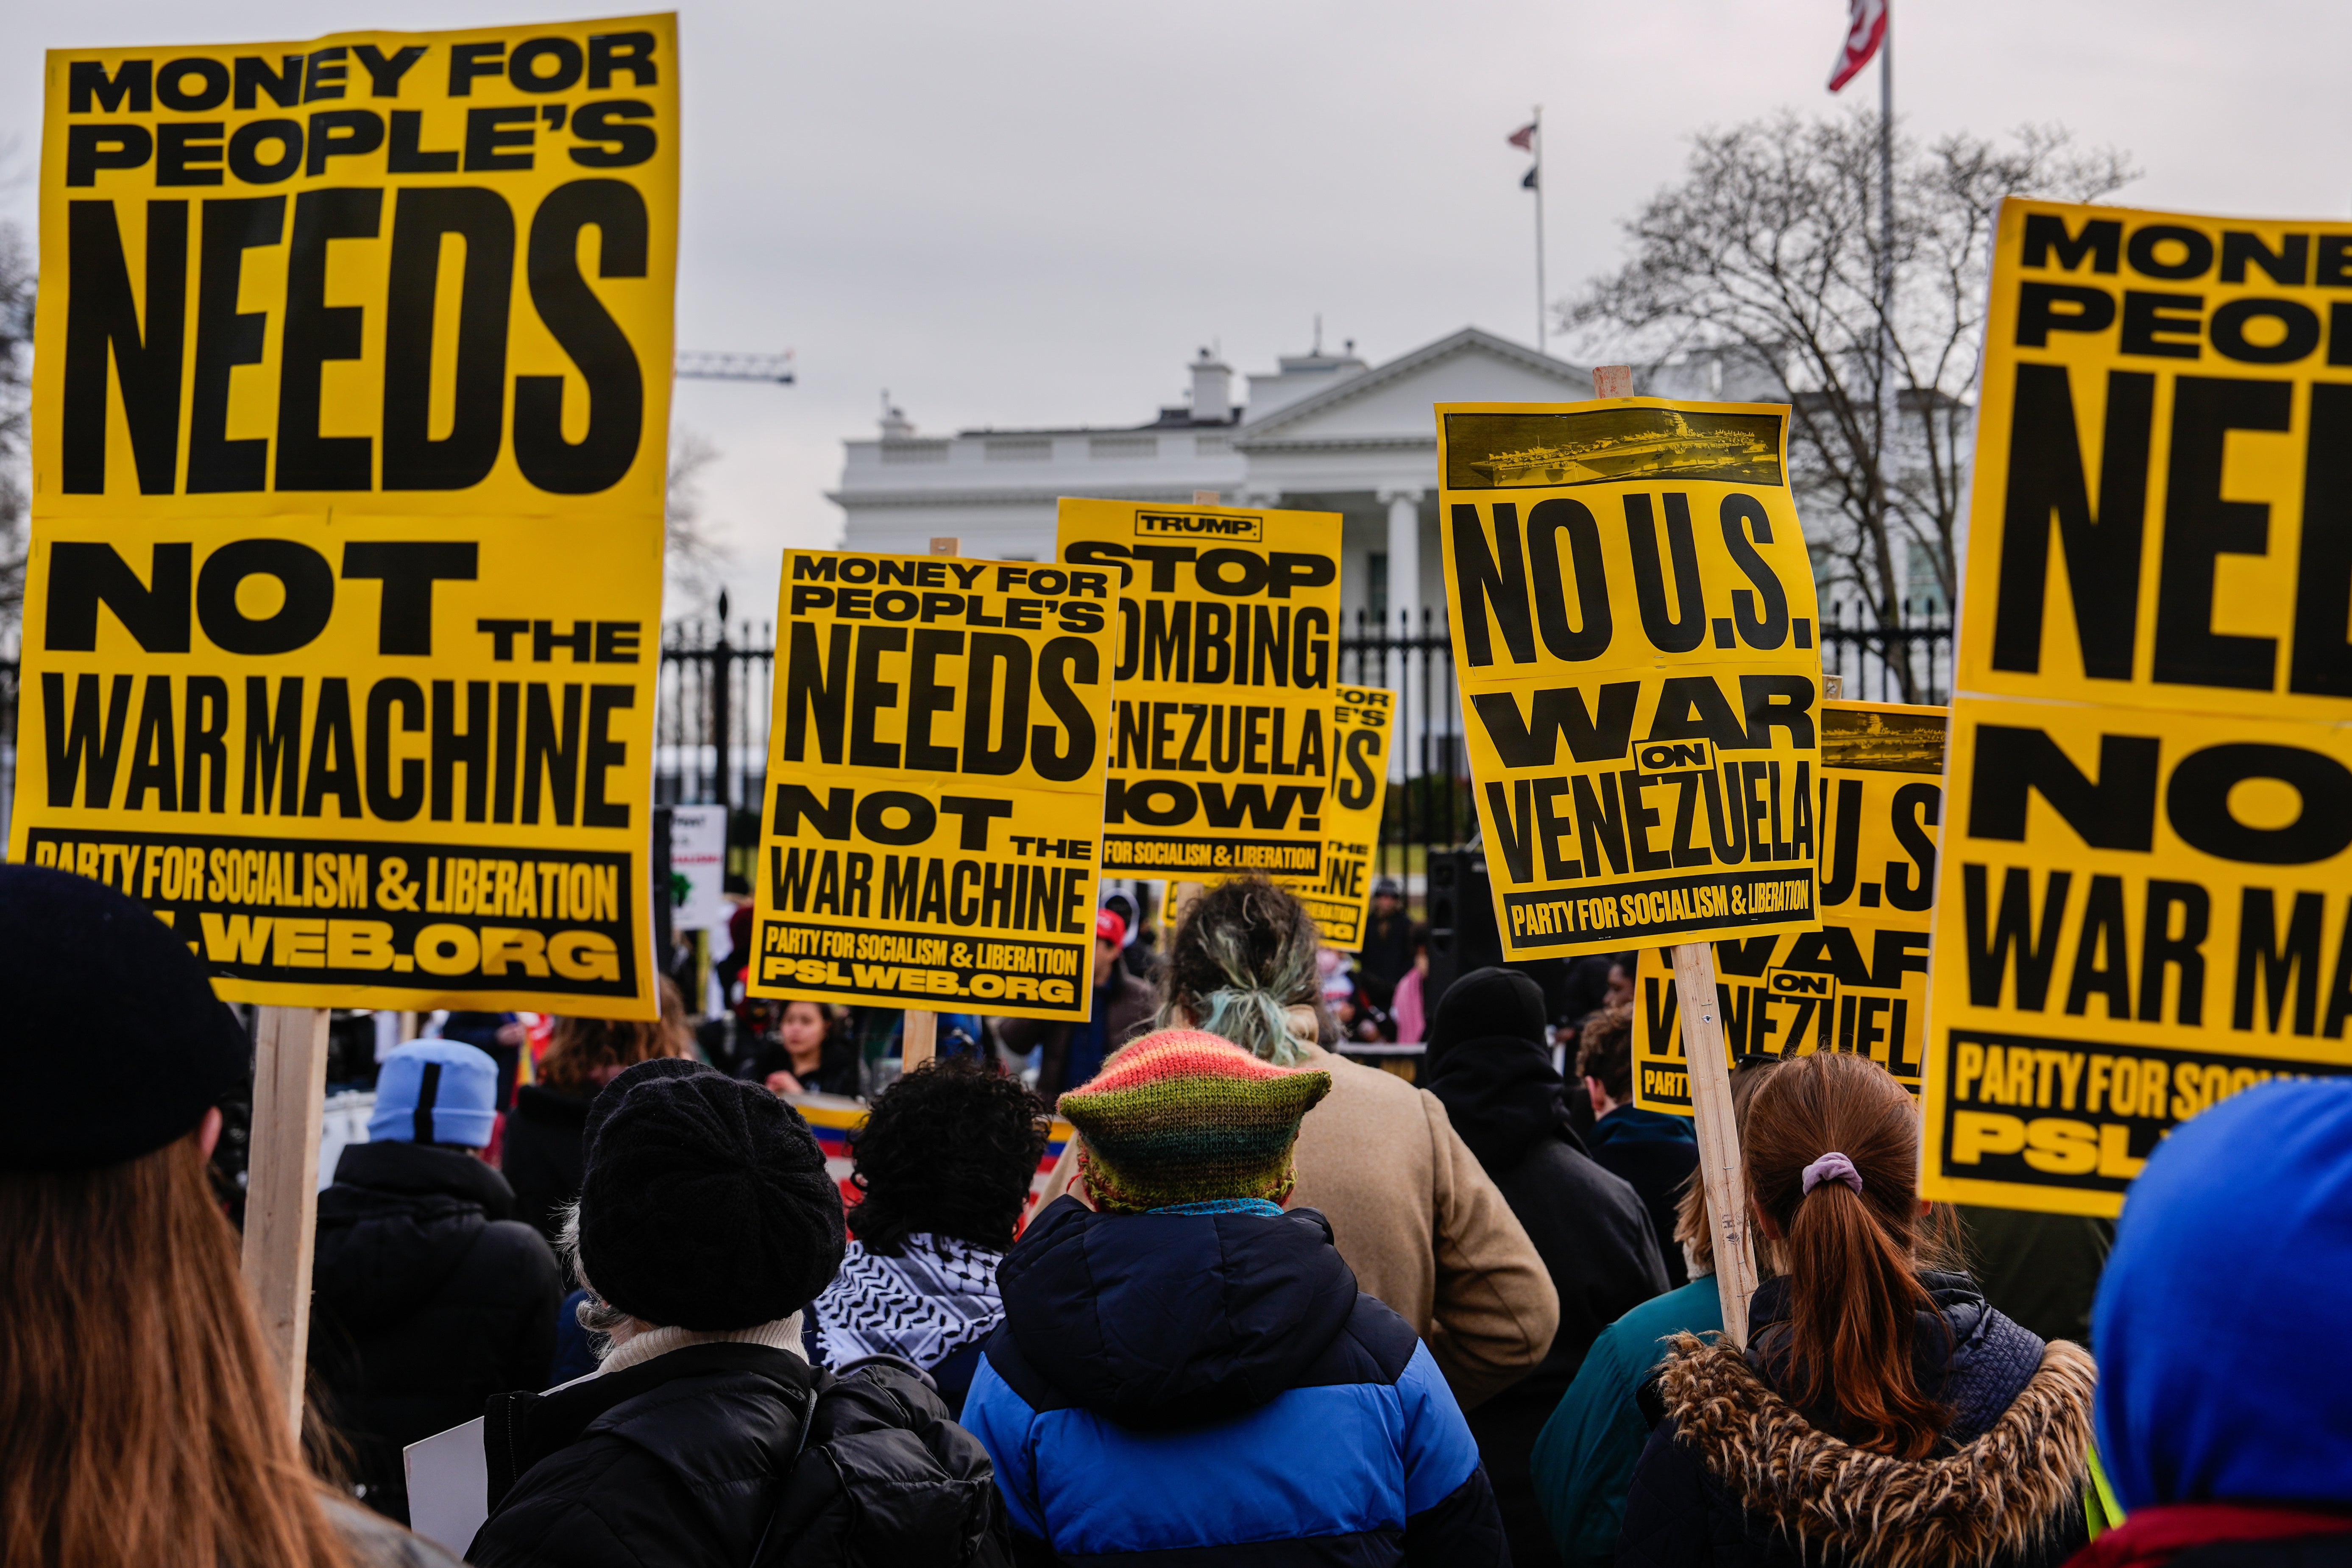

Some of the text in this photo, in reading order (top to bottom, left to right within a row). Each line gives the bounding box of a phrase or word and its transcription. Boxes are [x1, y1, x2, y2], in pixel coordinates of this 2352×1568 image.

[68, 31, 658, 114] MONEY FOR
[66, 100, 657, 187] PEOPLE'S
[2019, 212, 2352, 288] MONE
[62, 178, 649, 496] NEEDS
[2013, 280, 2352, 367] PEO
[1140, 515, 1257, 536] TRUMP:
[44, 538, 479, 656] NOT
[791, 585, 1105, 633] PEOPLE'S
[793, 555, 1108, 598] MONEY FOR
[1065, 541, 1336, 599] STOP
[1451, 493, 1813, 667] NO U.S.
[477, 619, 641, 663] THE
[1115, 597, 1329, 689] OMBING
[784, 621, 1100, 782] NEEDS
[1108, 699, 1326, 777] NEZUELA
[1469, 675, 1816, 769] WAR
[42, 672, 635, 828] WAR MACHINE
[1641, 743, 1705, 769] ON
[773, 784, 1013, 851] NOT
[1485, 761, 1814, 884] VENEZUELA
[1966, 724, 2352, 867] NO
[142, 845, 205, 901] FOR
[208, 848, 368, 909] SOCIALISM
[375, 856, 421, 912] &
[426, 856, 619, 923] LIBERATION
[1009, 836, 1092, 861] THE
[1103, 841, 1316, 870] FOR SOCIALISM & LIBERATION
[771, 847, 1089, 934] WAR MACHINE
[1513, 880, 1809, 937] PARTY FOR SOCIALISM & LIBERATION
[153, 910, 620, 982] WEB.ORG
[763, 956, 1075, 1004] PSLWEB.ORG
[766, 926, 1078, 976] PARTY FOR SOCIALISM & LIBERATION
[1772, 973, 1827, 994] ON
[1962, 862, 2212, 1028] WAR
[1954, 1040, 2086, 1111] PARTY
[2085, 1053, 2170, 1120] FOR
